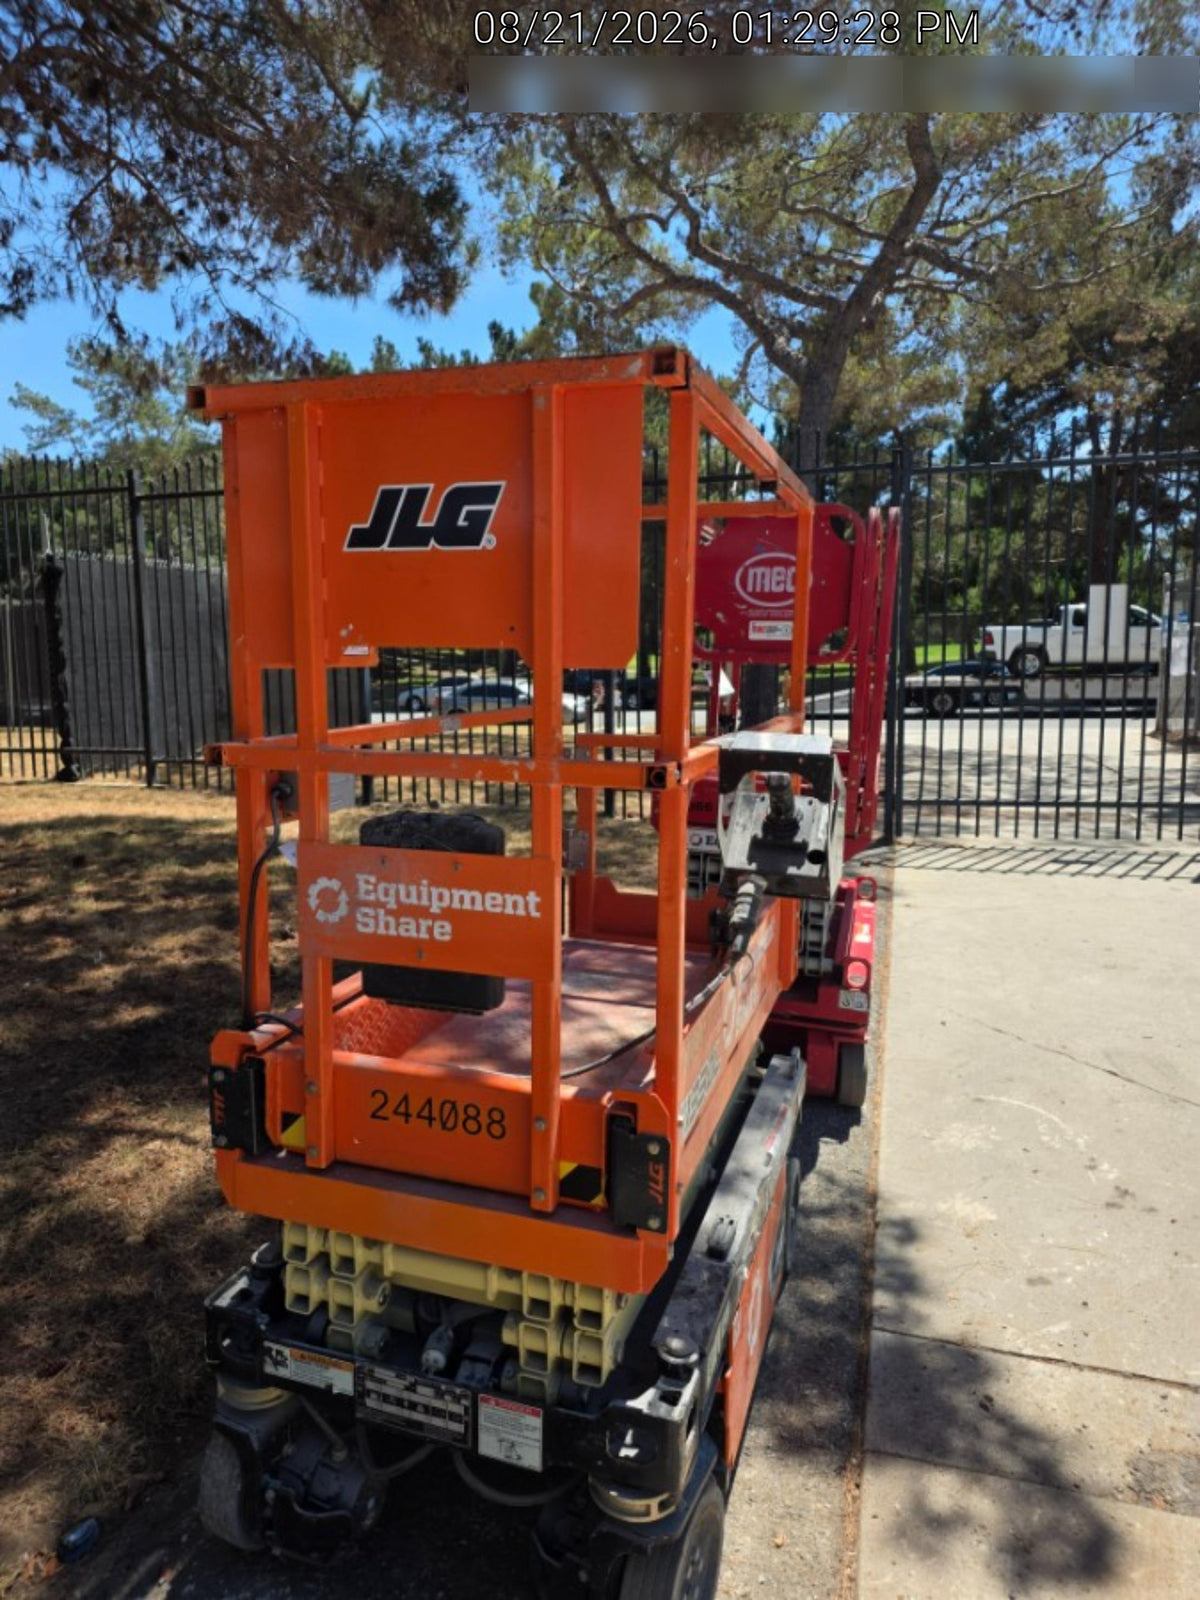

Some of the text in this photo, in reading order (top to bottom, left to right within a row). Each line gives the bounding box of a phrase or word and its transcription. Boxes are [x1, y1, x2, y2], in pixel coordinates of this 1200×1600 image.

[343, 481, 506, 552] JLG
[355, 873, 541, 918] Equipment
[355, 906, 452, 941] Share
[369, 1088, 507, 1140] 244088
[648, 1160, 664, 1206] JLG
